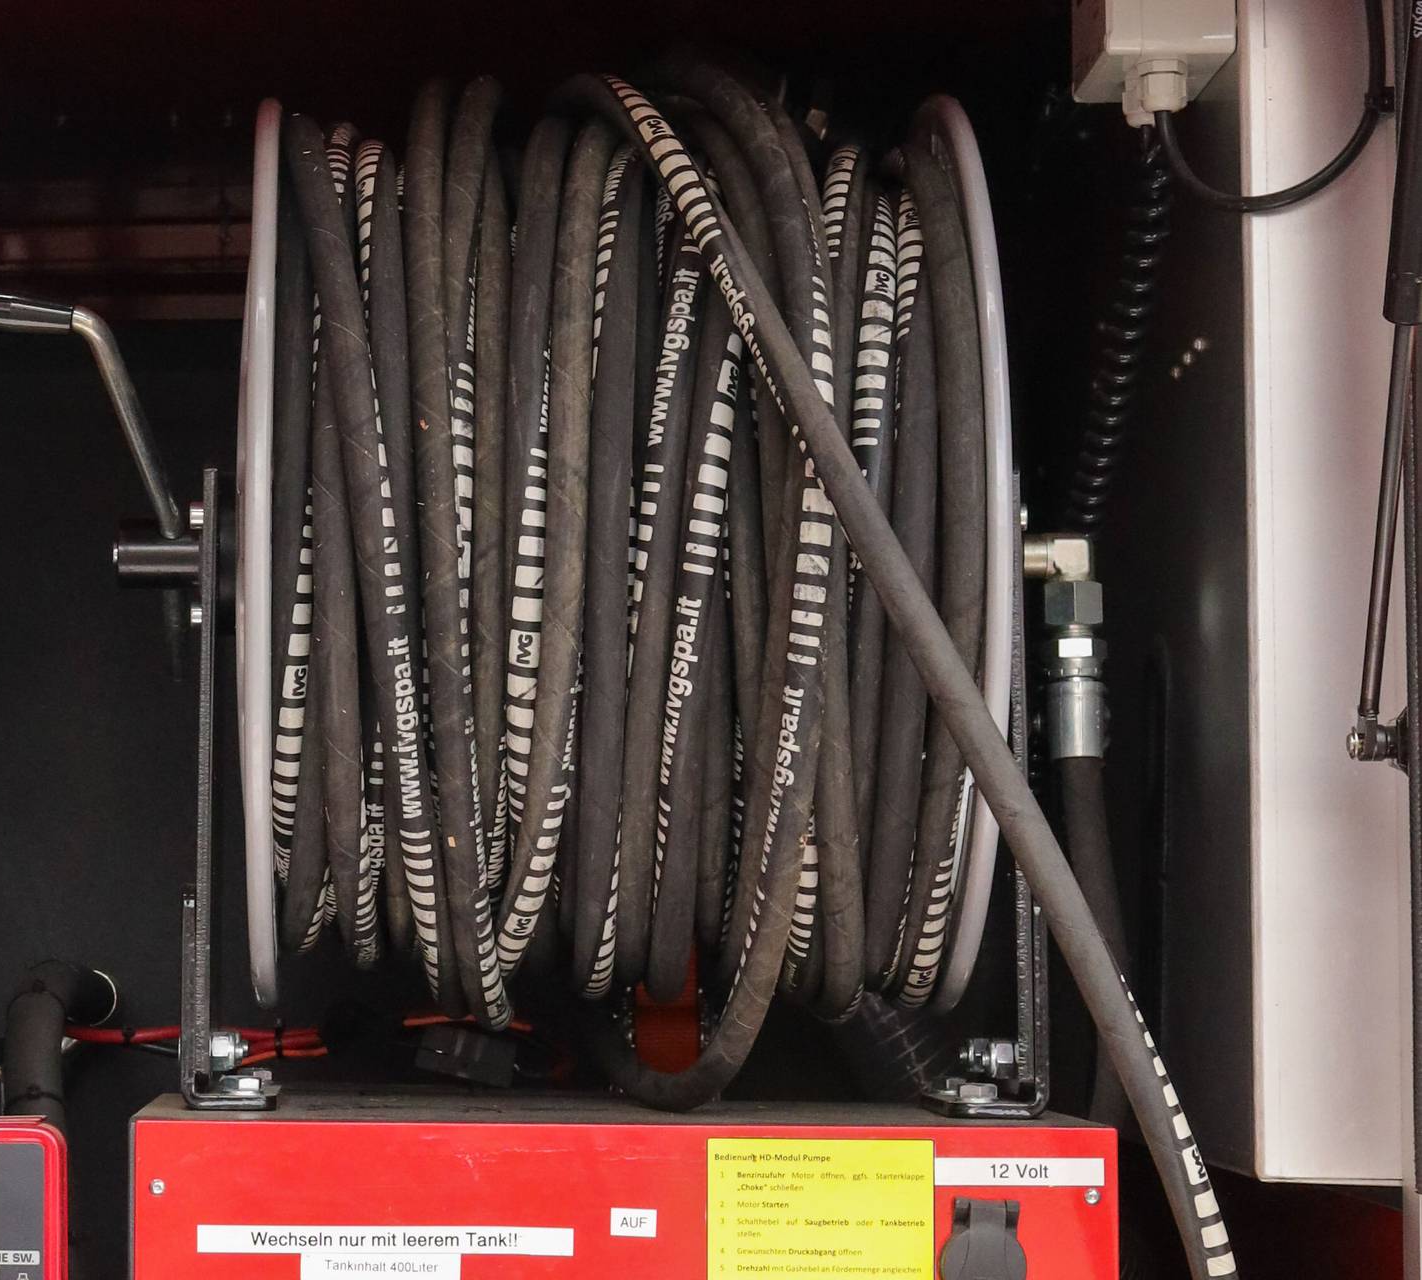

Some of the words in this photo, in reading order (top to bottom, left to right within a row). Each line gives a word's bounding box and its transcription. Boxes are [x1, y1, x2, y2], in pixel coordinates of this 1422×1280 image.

[872, 272, 890, 294] IVG
[647, 267, 700, 448] www.ivgspa.it
[517, 634, 533, 664] IVG
[292, 667, 307, 697] IVG
[660, 596, 703, 786] www.ivgspa.it
[387, 634, 424, 820] www.ivgspa.it
[515, 915, 532, 934] IVG
[759, 1154, 801, 1162] HD-Modul
[803, 1154, 831, 1163] Pumpe
[737, 1171, 785, 1179] Benzinzufuhr
[791, 1172, 815, 1180] Motor
[875, 1173, 925, 1182] Starterklappe
[990, 1164, 1009, 1178] 12
[1016, 1164, 1049, 1179] Volt
[762, 1201, 789, 1209] Starten
[620, 1217, 647, 1228] AUF
[737, 1218, 779, 1226] Schalthebel
[786, 1218, 798, 1226] auf
[804, 1219, 849, 1228] Saugbetrieb
[880, 1219, 925, 1227] Tankbetrieb
[251, 1231, 333, 1248] Wechseln
[339, 1234, 366, 1248] nur
[371, 1231, 396, 1248] mit
[402, 1232, 459, 1248] leerem
[466, 1232, 518, 1248] Tank!!
[737, 1230, 761, 1238] stellen
[13, 1253, 35, 1263] SW.
[788, 1248, 836, 1257] Druckabgang
[325, 1259, 387, 1273] Tankinhalt
[390, 1260, 438, 1274] 400Liter
[737, 1264, 770, 1272] Drehzahl
[786, 1265, 820, 1273] Gashebel
